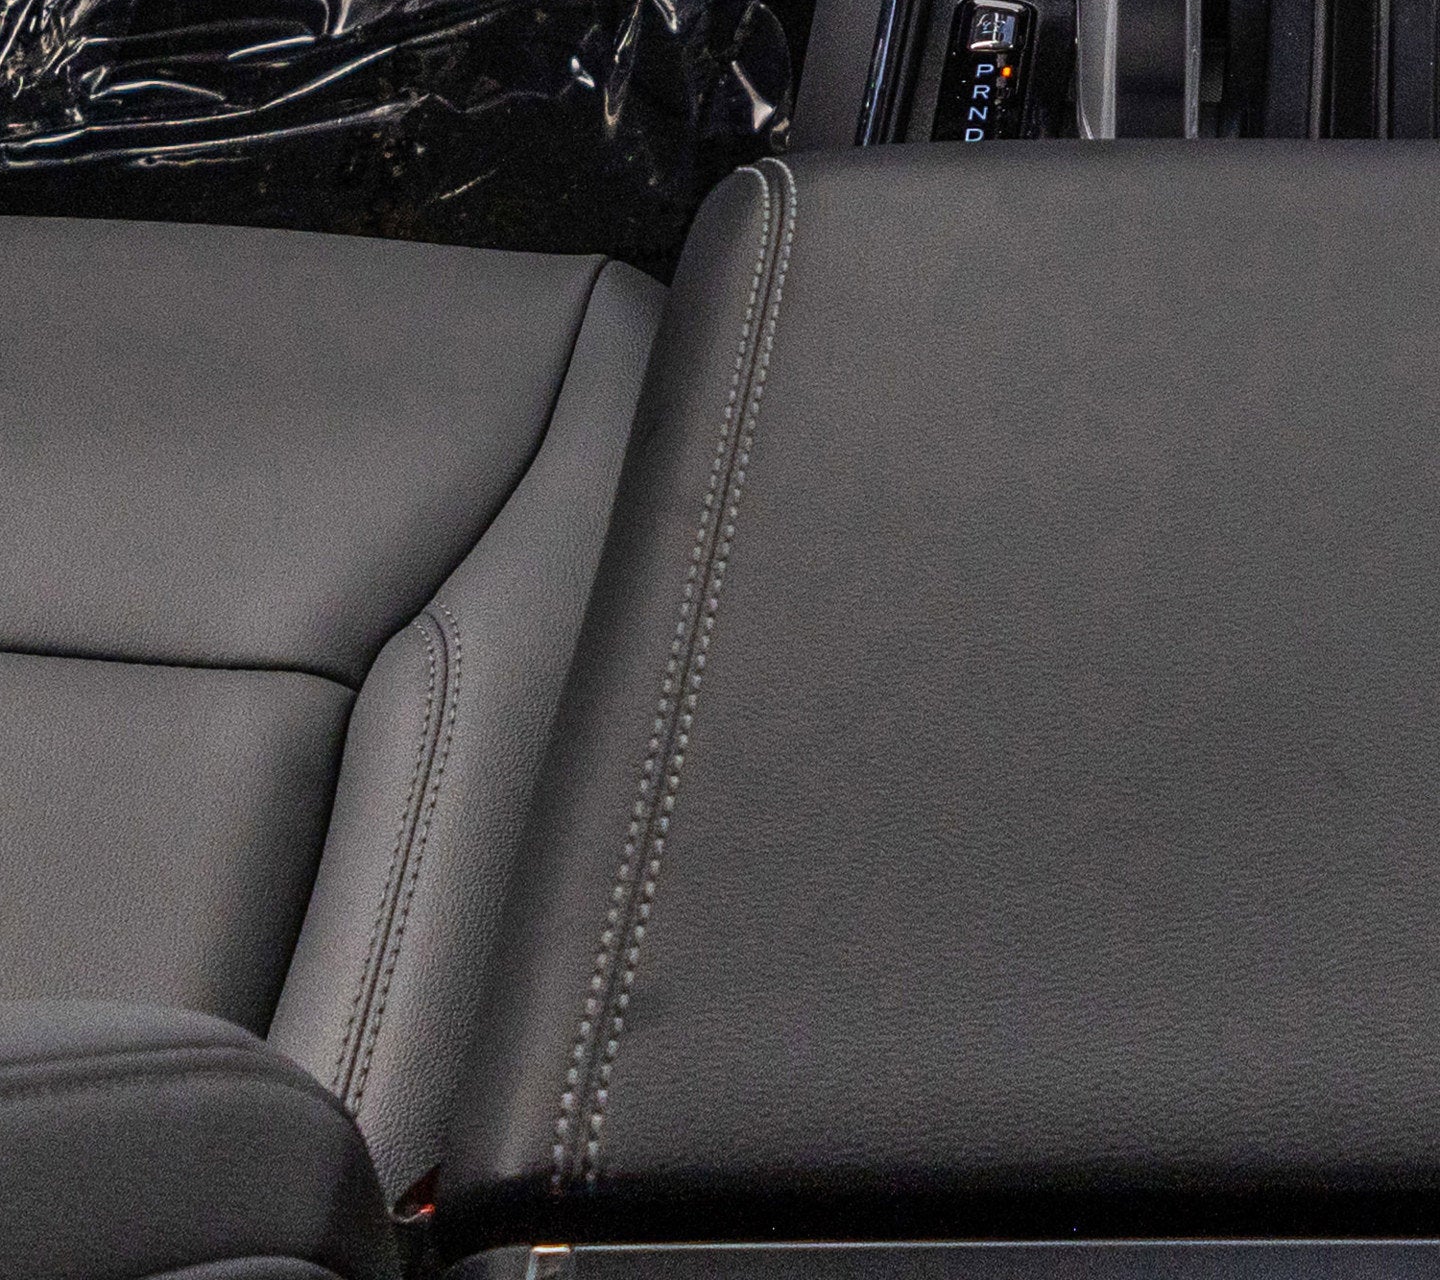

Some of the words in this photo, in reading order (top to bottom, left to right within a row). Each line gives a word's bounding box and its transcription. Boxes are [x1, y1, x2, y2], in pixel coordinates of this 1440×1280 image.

[976, 63, 994, 78] P
[972, 84, 990, 99] R
[968, 106, 988, 121] N
[965, 128, 984, 142] D
